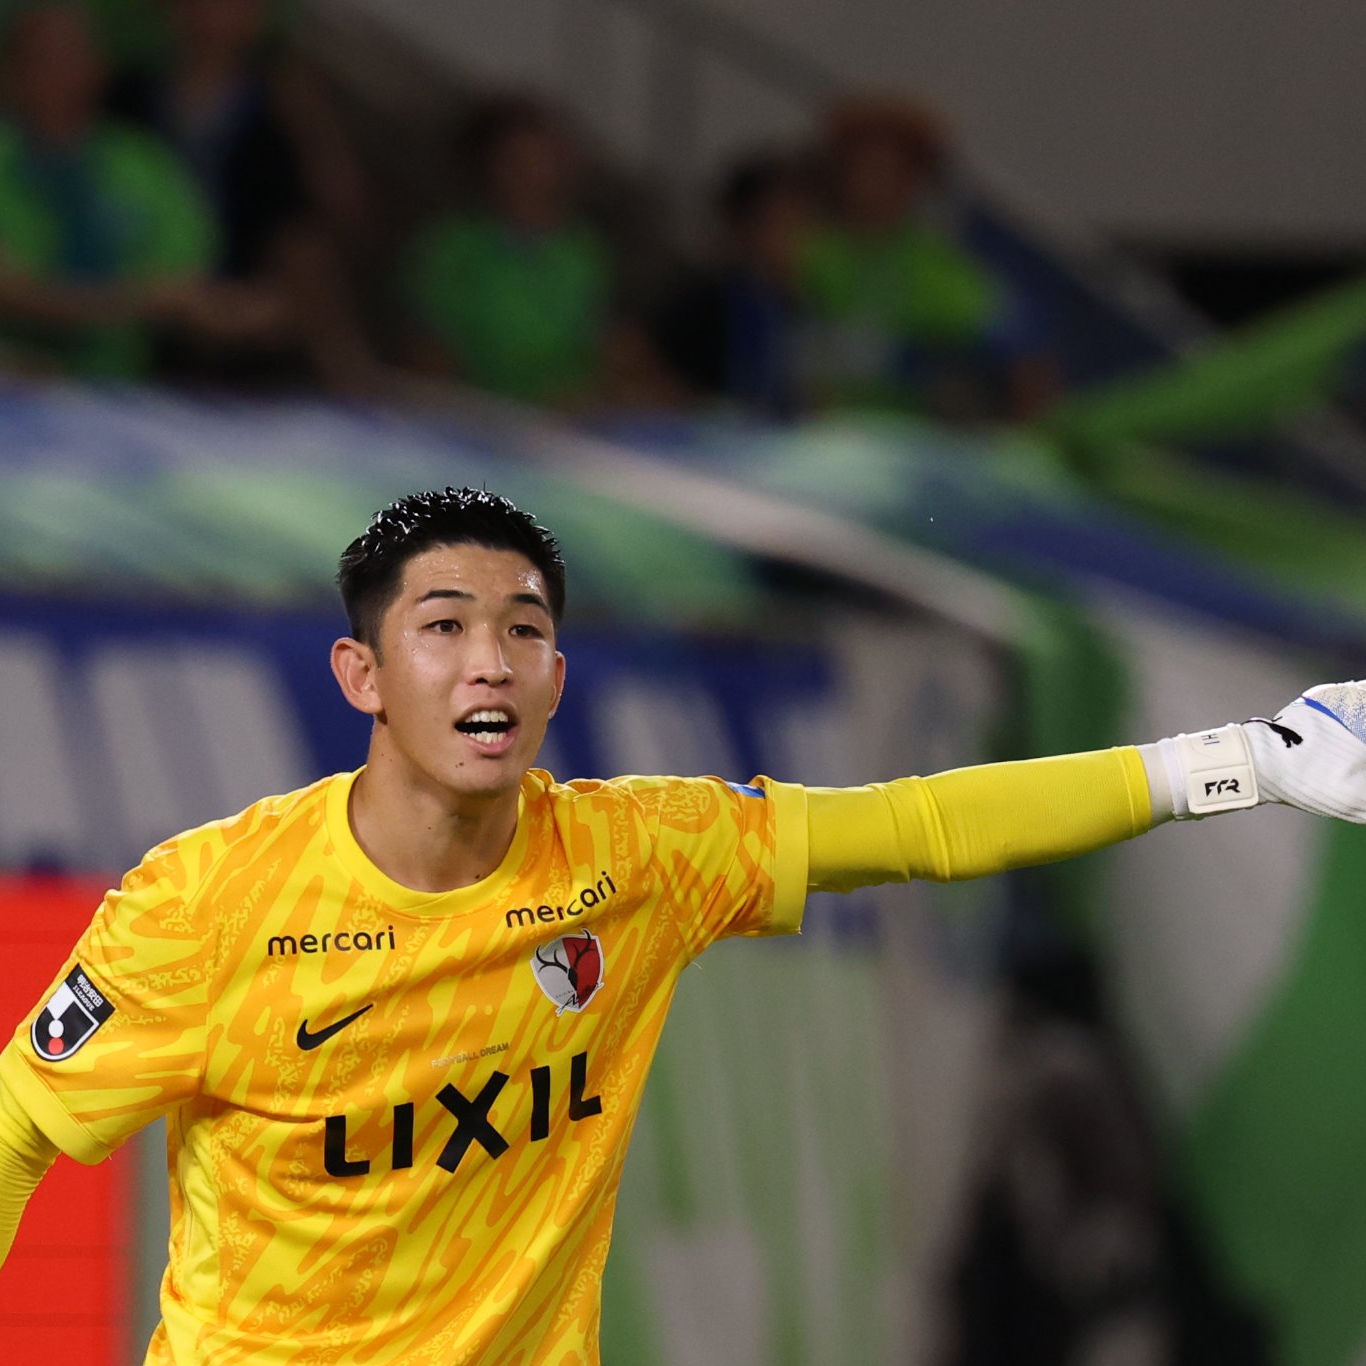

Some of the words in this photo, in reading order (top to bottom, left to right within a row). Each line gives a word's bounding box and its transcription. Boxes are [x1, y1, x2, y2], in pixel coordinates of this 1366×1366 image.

[505, 871, 617, 929] mercari
[267, 925, 396, 957] mercari
[324, 1051, 602, 1177] LIXIL
